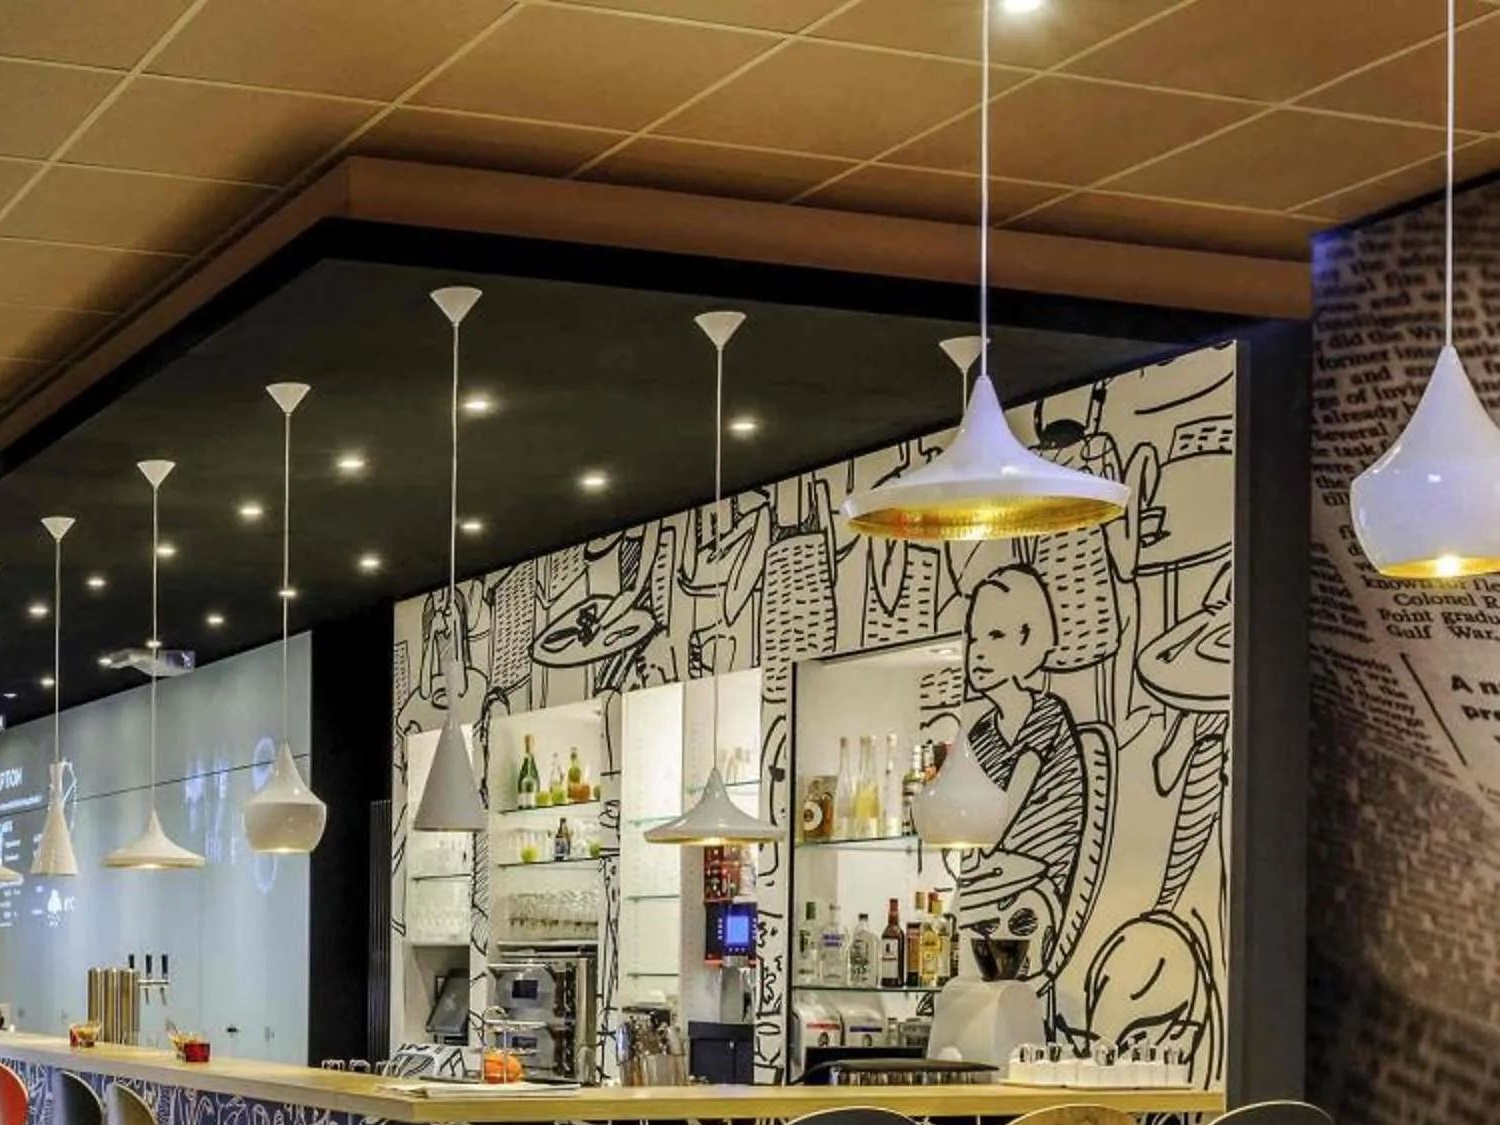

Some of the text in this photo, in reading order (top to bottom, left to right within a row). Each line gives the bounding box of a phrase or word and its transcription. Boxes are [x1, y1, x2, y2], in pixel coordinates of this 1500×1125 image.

[1350, 366, 1392, 386] and
[1346, 387, 1367, 404] of
[1322, 403, 1398, 424] already
[1392, 592, 1478, 607] Colonel
[1377, 607, 1434, 623] Point
[1386, 624, 1432, 639] Gulf
